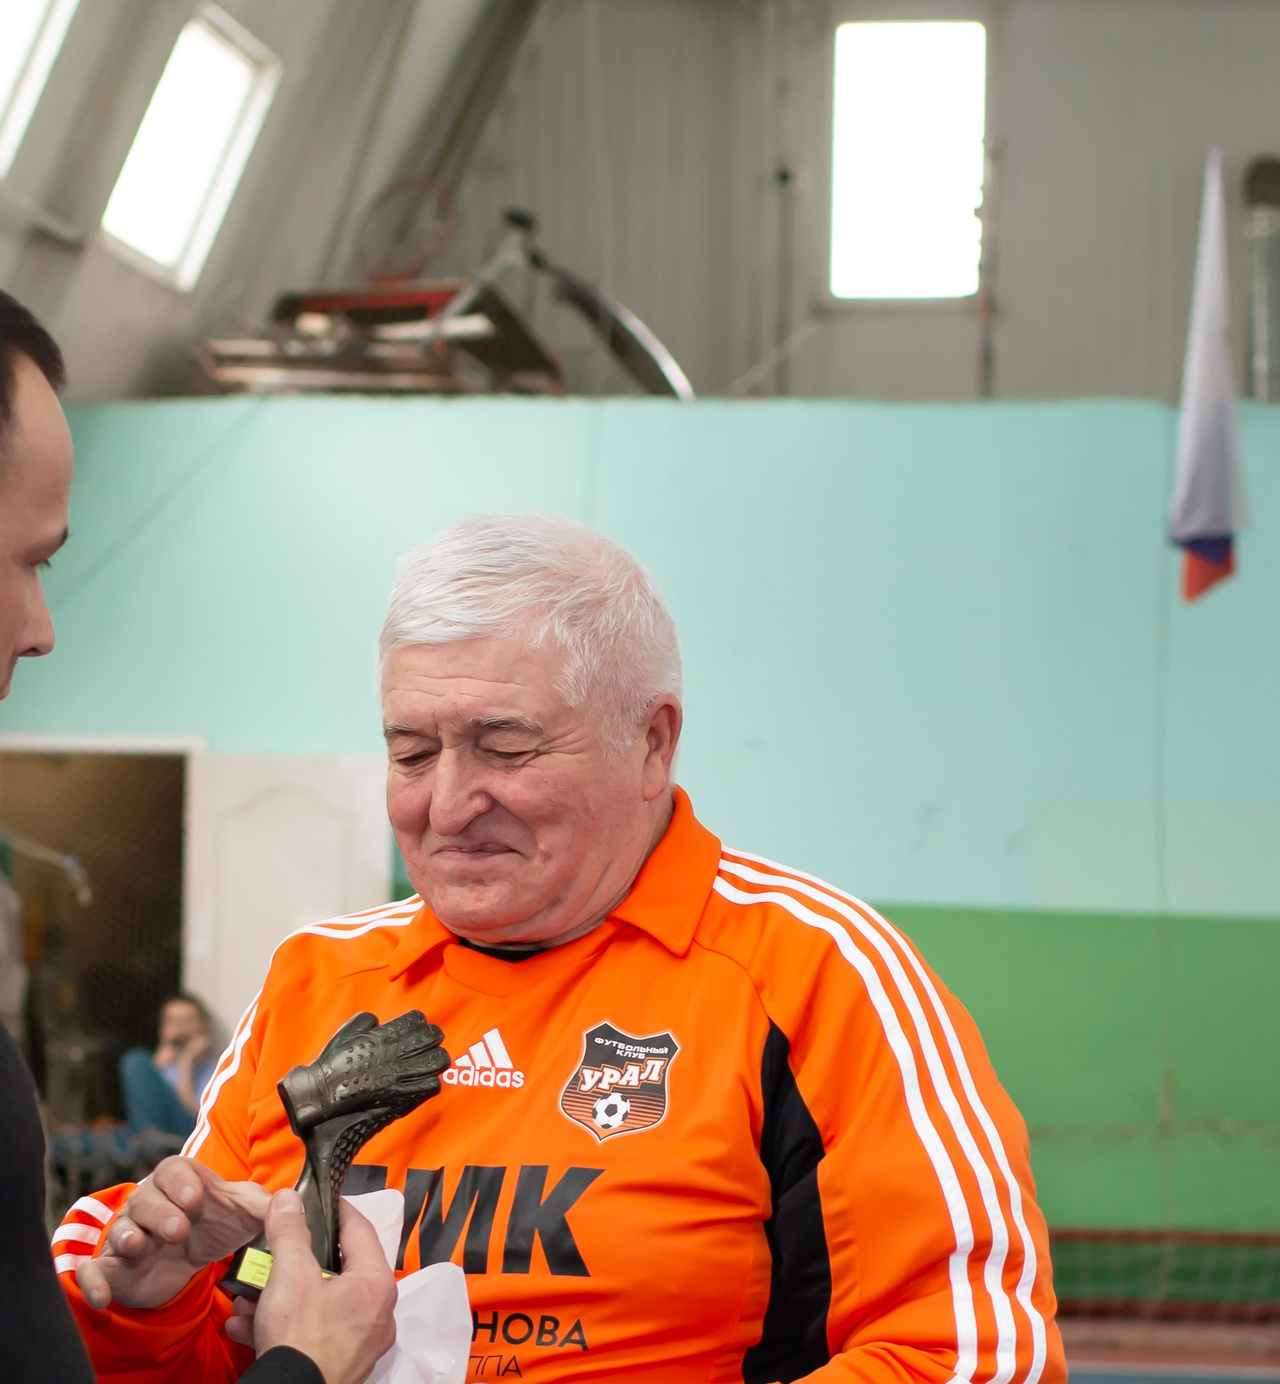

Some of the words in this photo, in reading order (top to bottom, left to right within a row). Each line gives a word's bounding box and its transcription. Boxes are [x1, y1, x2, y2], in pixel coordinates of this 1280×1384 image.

[594, 1037, 669, 1055] ФУТБОЛЬНЫЙ
[615, 1048, 646, 1060] КЛУБ
[442, 1065, 525, 1088] adidas
[579, 1058, 666, 1092] УРАЛ
